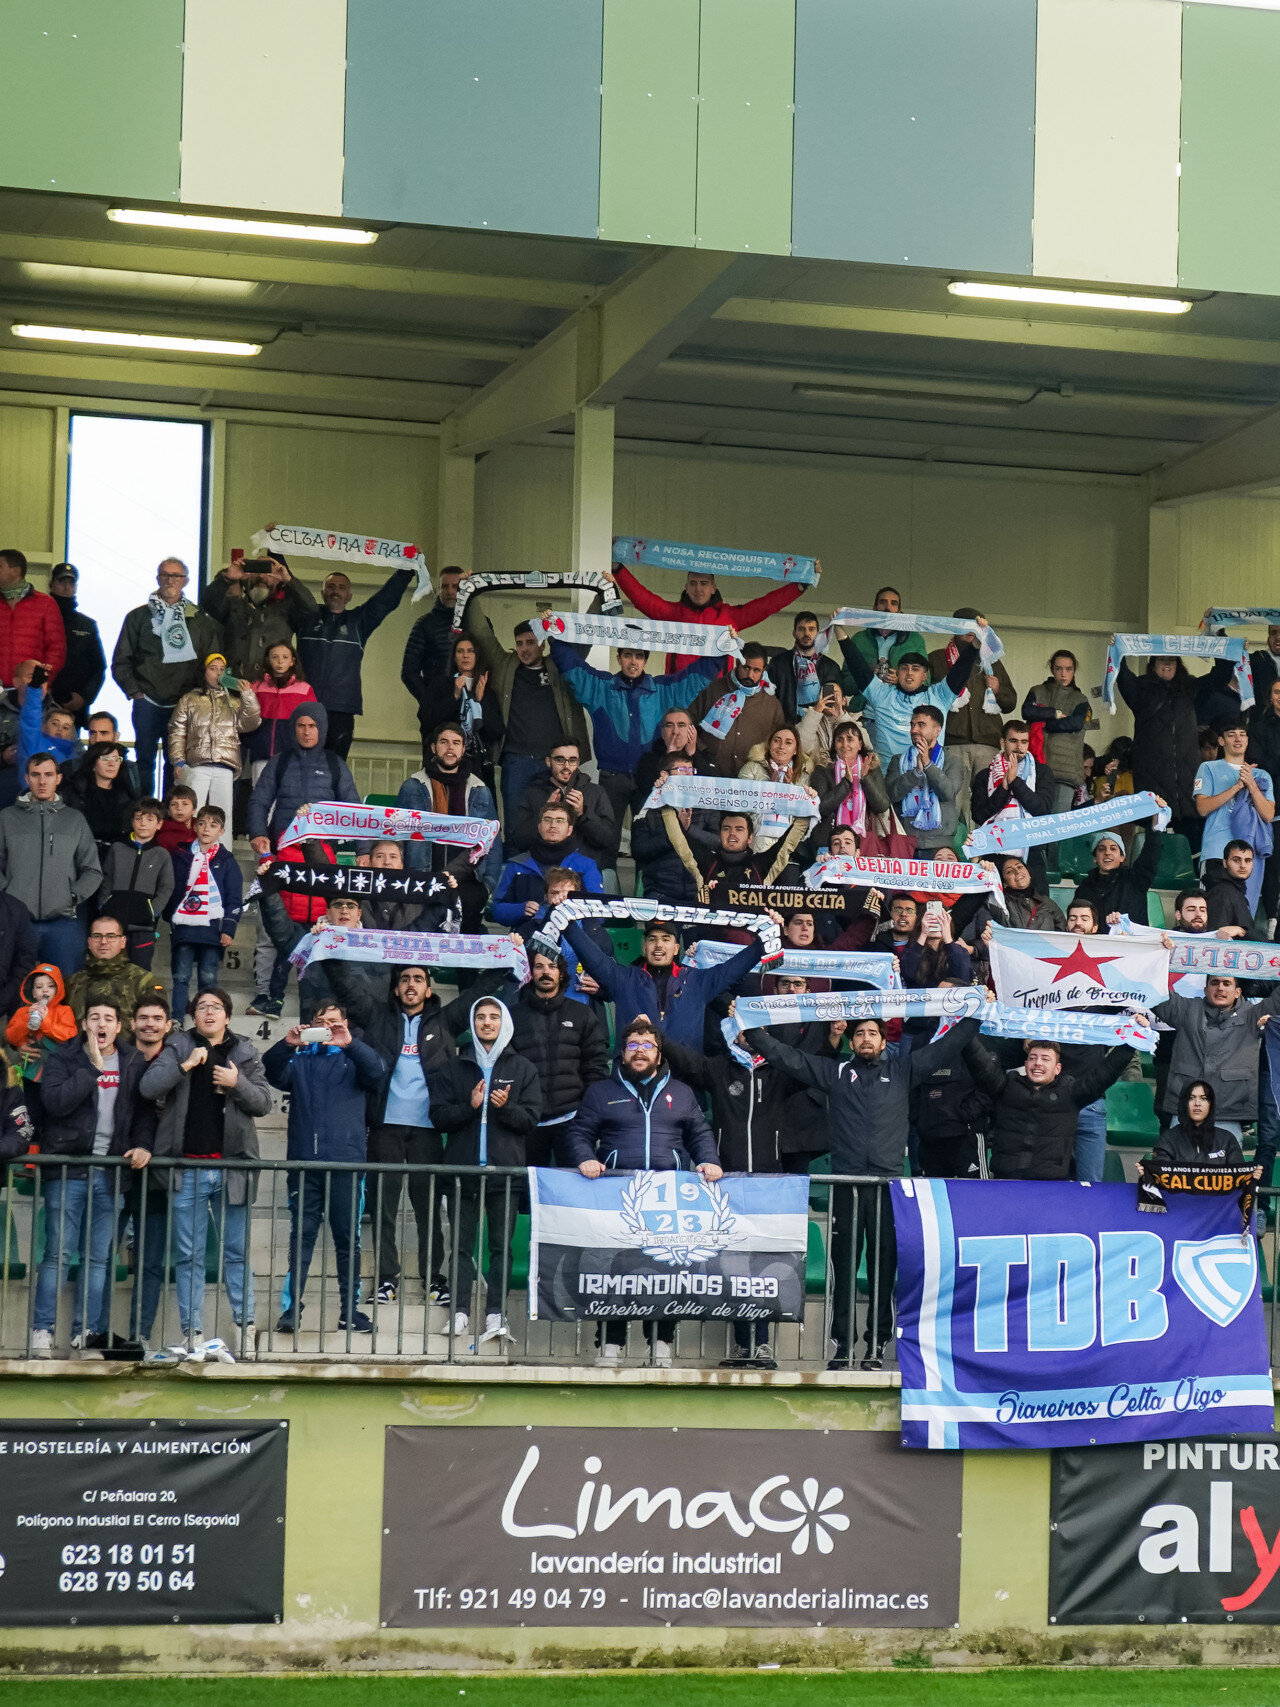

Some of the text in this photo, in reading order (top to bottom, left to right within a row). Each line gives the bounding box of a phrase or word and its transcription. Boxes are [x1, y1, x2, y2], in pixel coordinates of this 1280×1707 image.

[338, 537, 361, 552] RA
[377, 543, 401, 558] RA
[652, 545, 777, 566] A NOSA RECONQUISTA
[662, 557, 687, 567] FINAL
[690, 560, 729, 571] TEMPADA
[575, 622, 706, 646] BOINAS CELESTES
[1123, 635, 1229, 655] RC CELTA
[714, 787, 758, 798] puidemos
[698, 797, 776, 811] ASCENSO 2012
[1011, 794, 1142, 833] A NOSA RECONQUISTA
[1025, 809, 1134, 841] FINAL TEMPADA 2018-19
[856, 857, 974, 879] CELTA DE VIGO
[728, 889, 766, 907] REAL
[768, 892, 804, 908] CLUB
[806, 893, 846, 910] CELTA
[542, 898, 783, 954] BOINAS CELESTES
[381, 936, 433, 953] CELTA
[617, 942, 629, 951] 15
[226, 951, 241, 970] 5
[1013, 986, 1062, 1009] Tropas
[1066, 986, 1083, 1000] de
[256, 1020, 272, 1041] 4
[1193, 1174, 1234, 1191] CLUB
[579, 1270, 779, 1298] IRMANDIÑOS 1923
[957, 1230, 1169, 1352] TDB
[585, 1300, 774, 1320] Siareiros Celta de Vigo
[997, 1376, 1226, 1424] Siareiros Celta Vigo
[13, 1438, 251, 1454] HOSTELERÍA Y ALIMENTACIÓN
[83, 1490, 178, 1505] C/ Peñalara 20,
[17, 1513, 74, 1530] Polígono
[134, 1514, 144, 1526] El
[147, 1514, 181, 1527] Cerro
[183, 1513, 240, 1529] (Segovia)
[61, 1545, 196, 1565] 623 18 01 51
[530, 1551, 782, 1574] lavandería industrial
[59, 1571, 195, 1592] 628 79 50 64
[414, 1587, 929, 1611] Tlf: 921 49 04 79 limac@lavanderialimac.es
